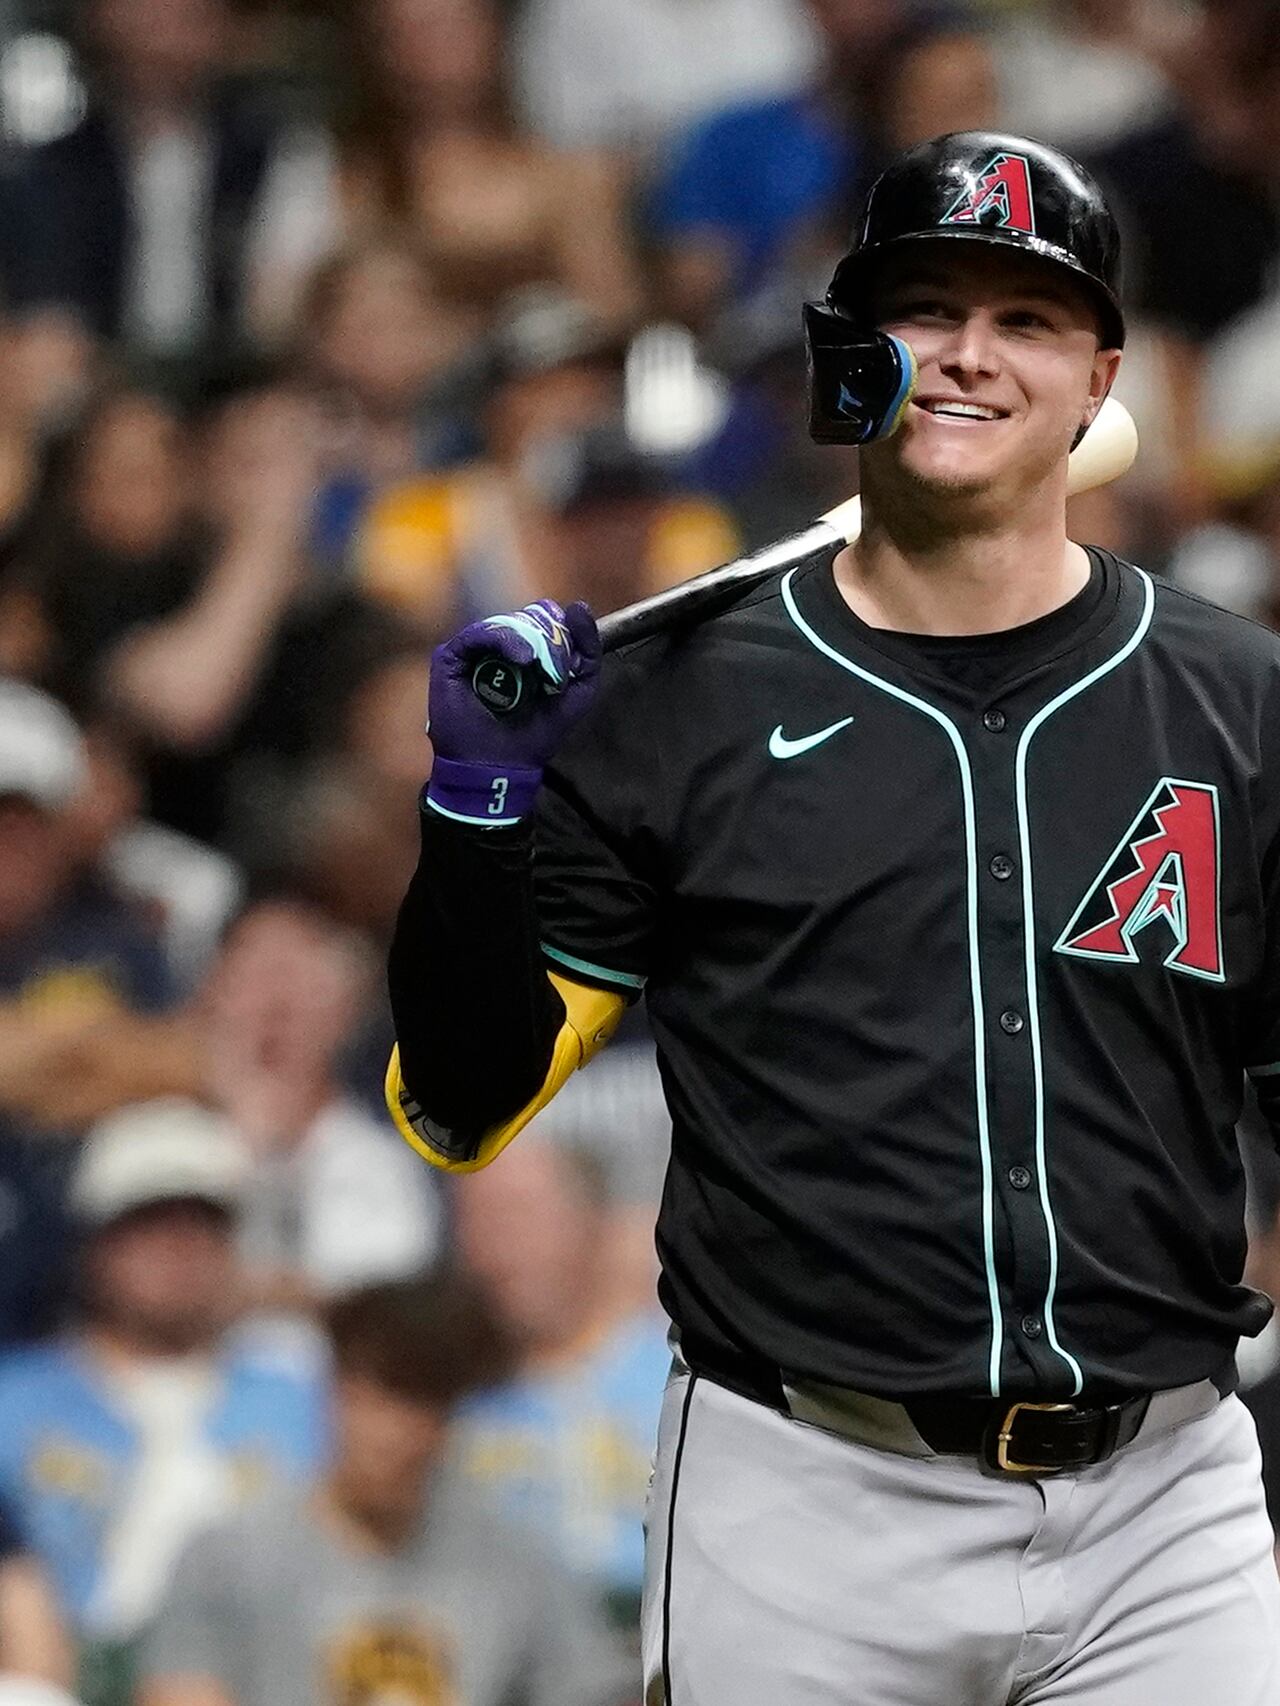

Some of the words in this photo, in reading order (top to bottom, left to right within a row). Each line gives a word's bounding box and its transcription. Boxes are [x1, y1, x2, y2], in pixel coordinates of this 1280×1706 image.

[938, 152, 1036, 236] A
[492, 668, 506, 688] 2
[487, 777, 509, 815] 3
[1052, 777, 1226, 983] A
